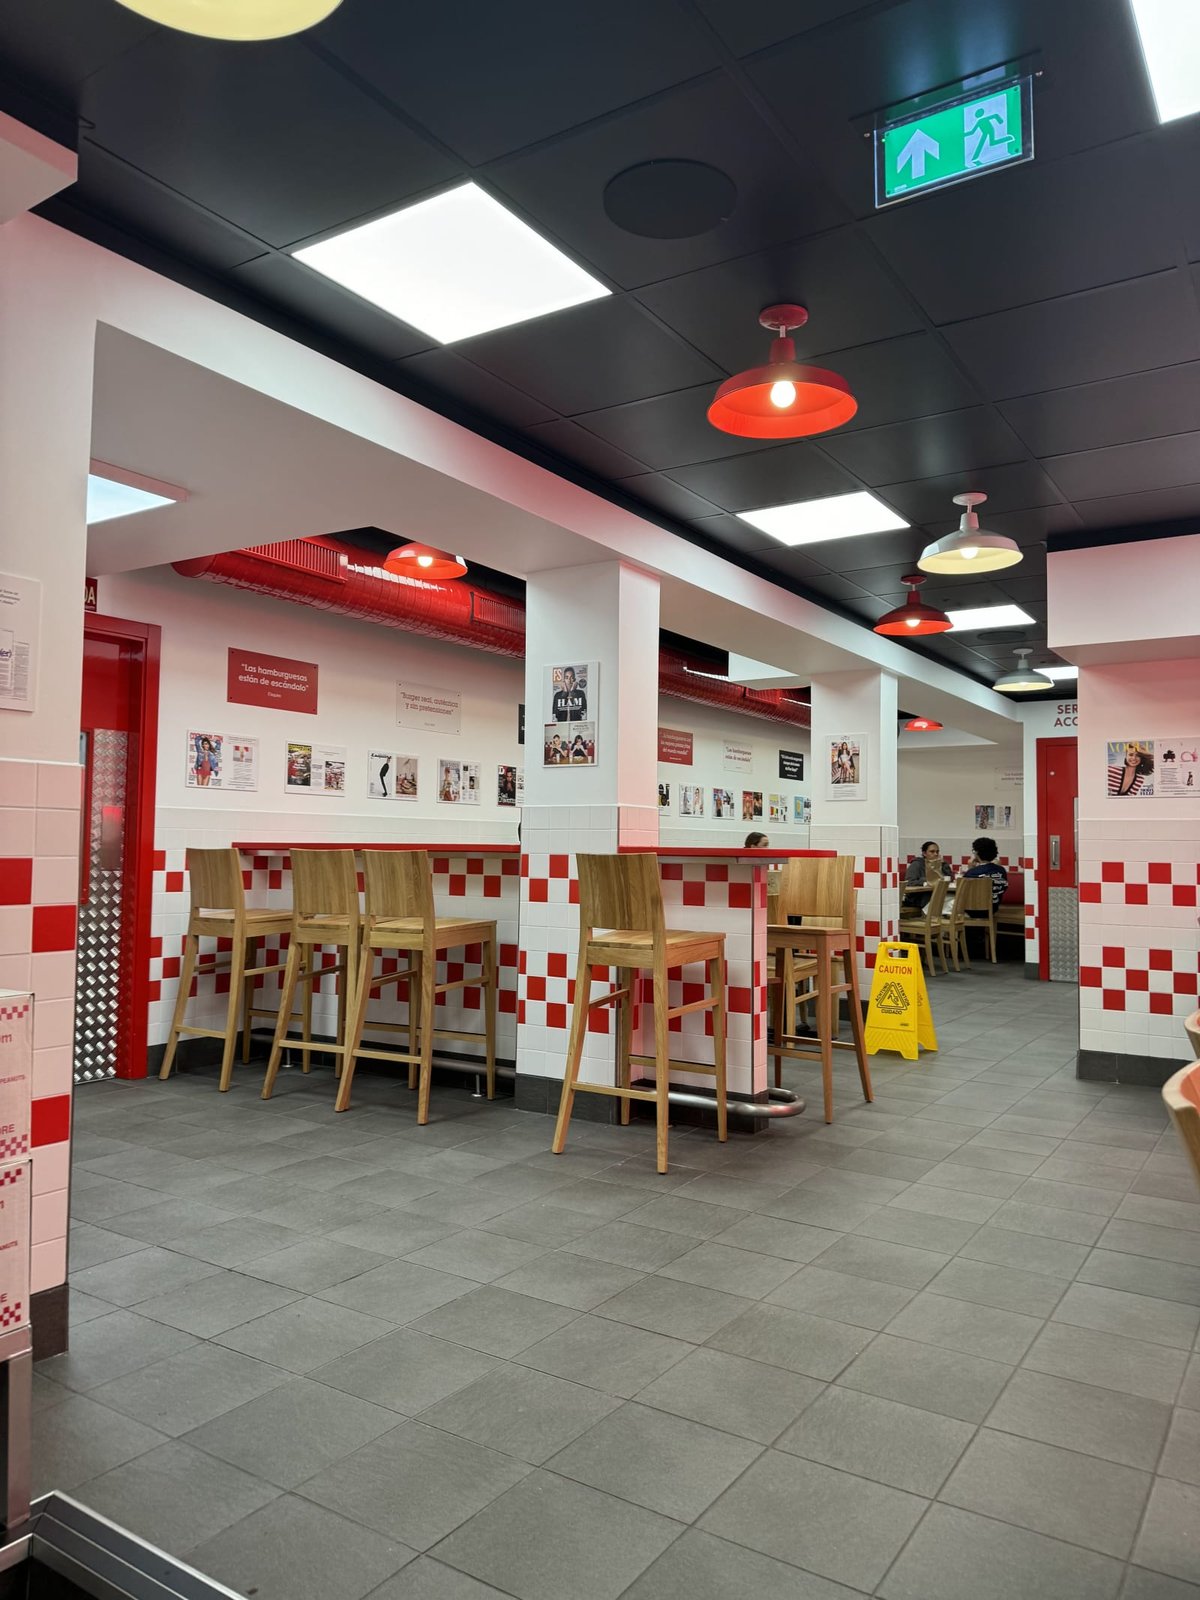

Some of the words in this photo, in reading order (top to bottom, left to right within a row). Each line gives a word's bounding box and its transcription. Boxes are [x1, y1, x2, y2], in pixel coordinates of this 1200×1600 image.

[258, 665, 308, 682] hamburguesas
[238, 674, 259, 684] están
[260, 677, 270, 686] de
[557, 697, 582, 707] HAM
[1057, 704, 1078, 715] SER
[879, 964, 913, 975] CAUTION
